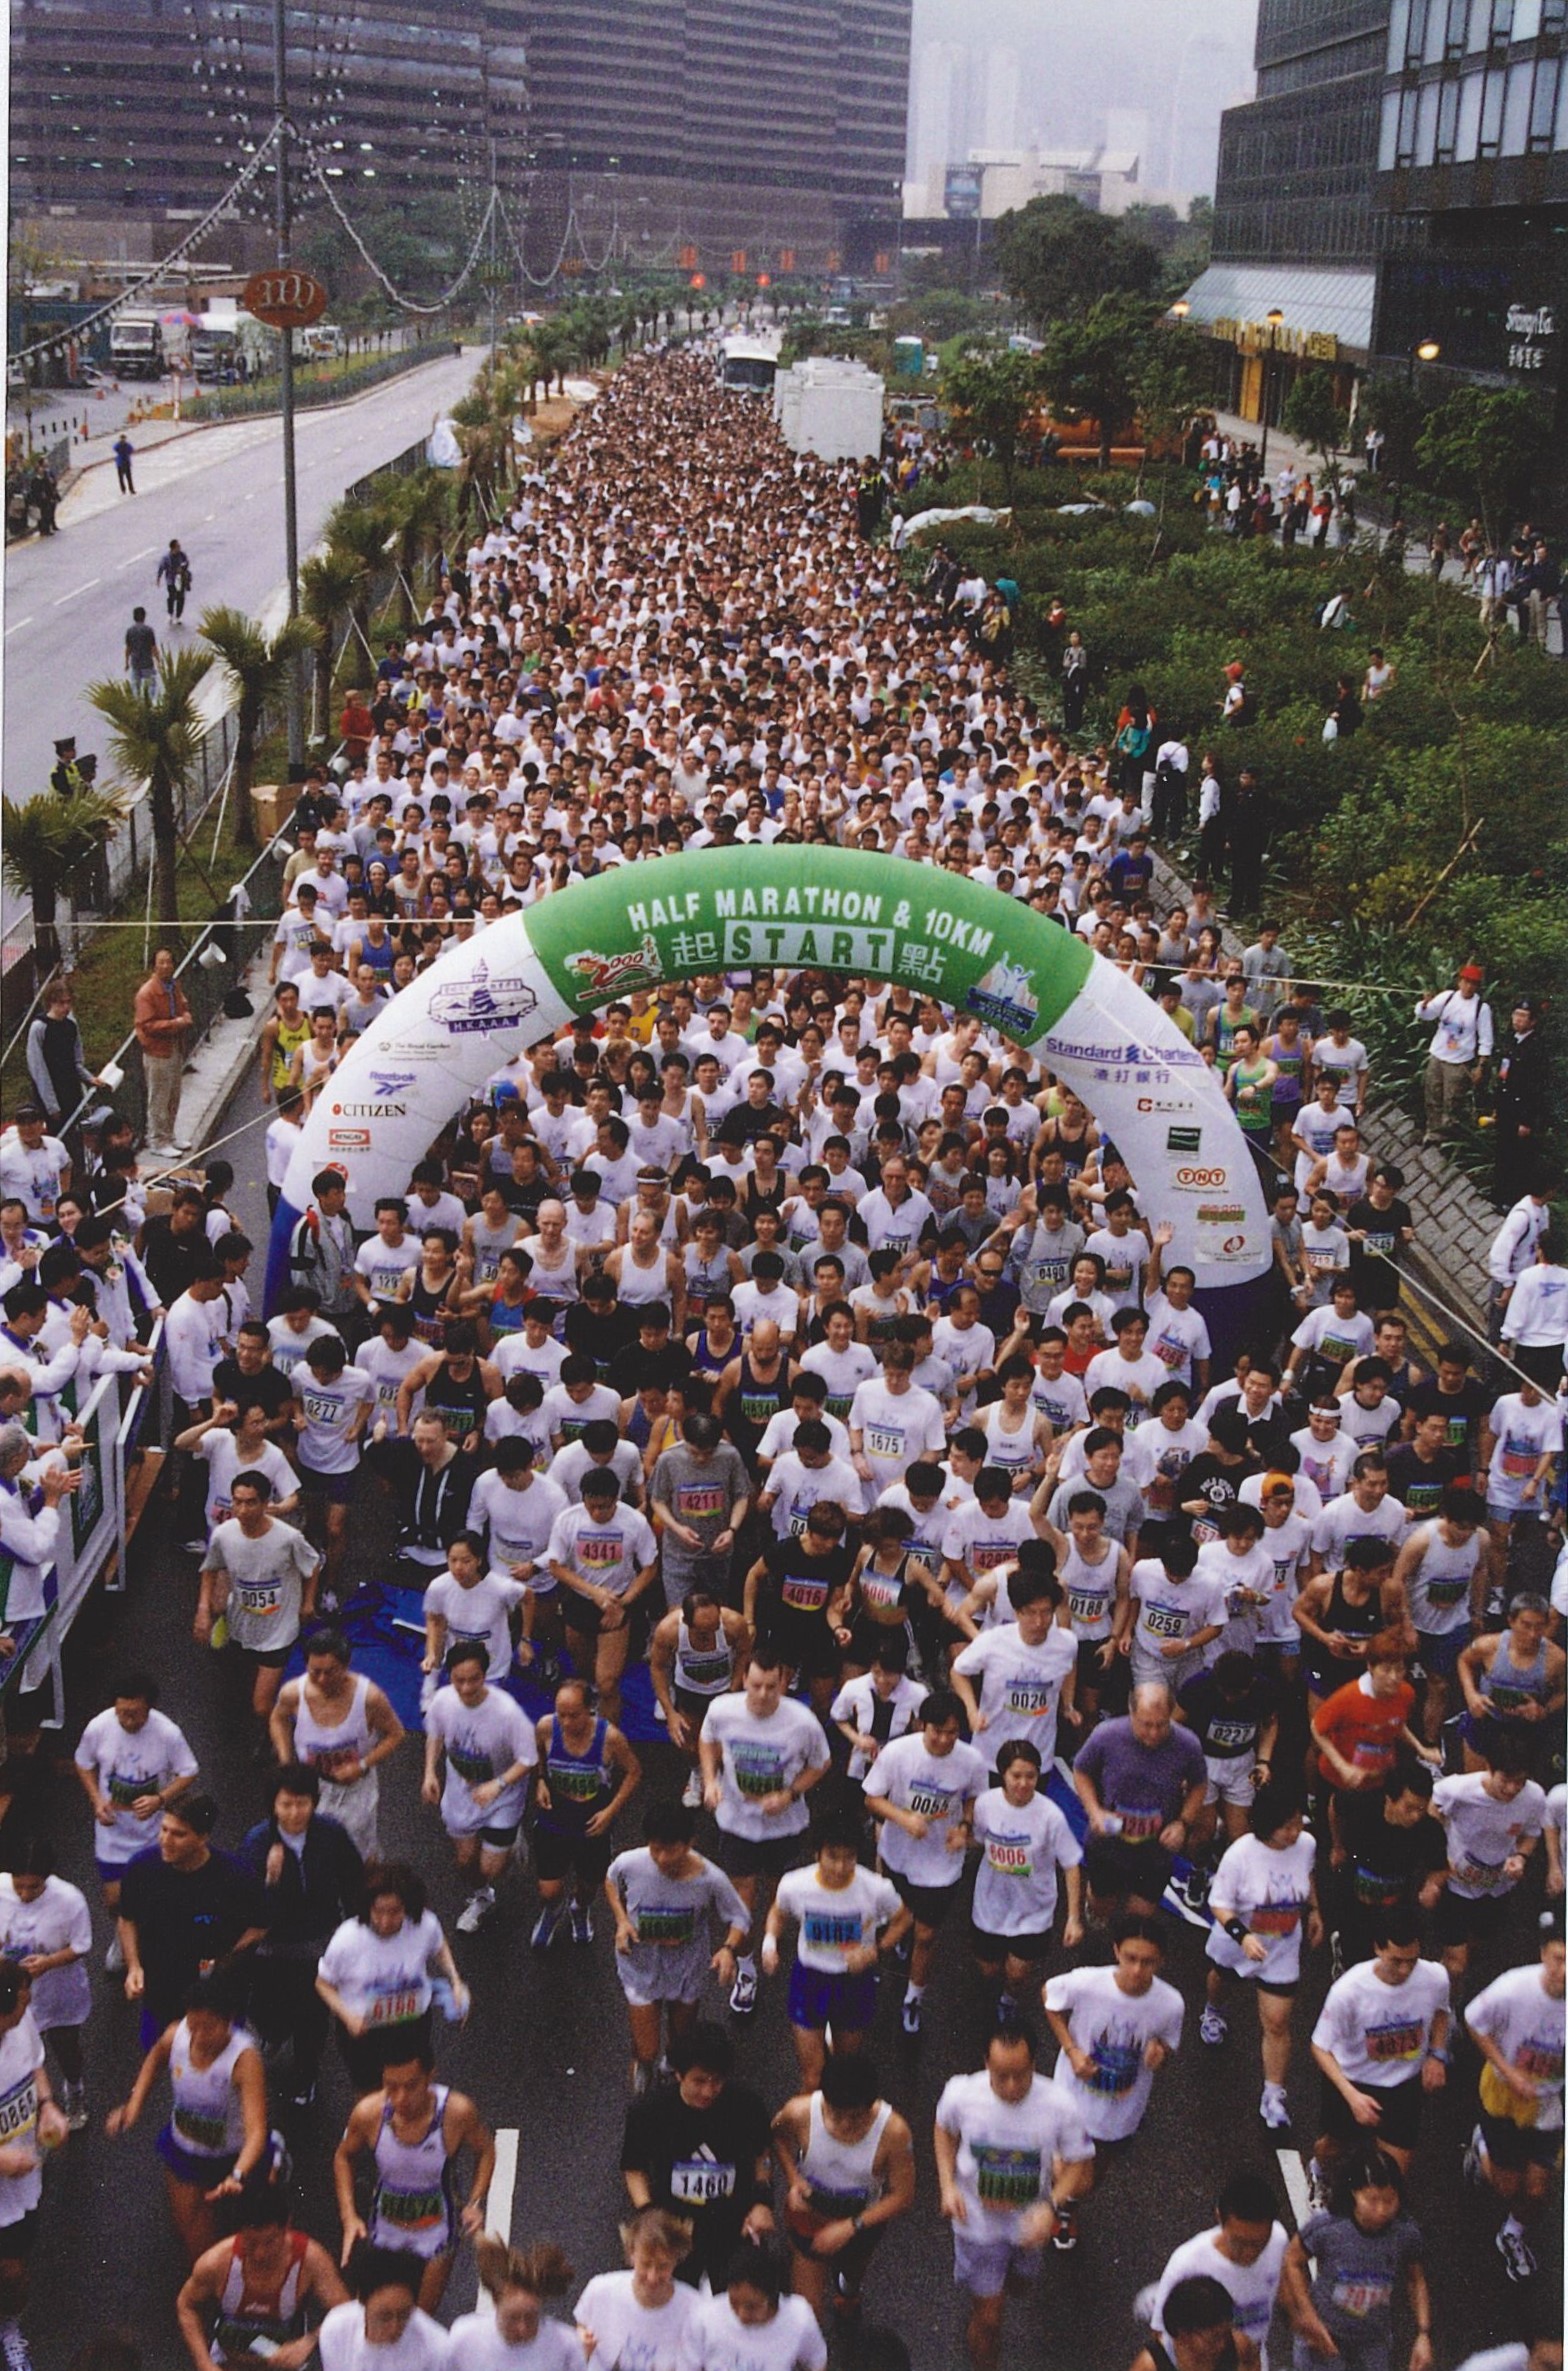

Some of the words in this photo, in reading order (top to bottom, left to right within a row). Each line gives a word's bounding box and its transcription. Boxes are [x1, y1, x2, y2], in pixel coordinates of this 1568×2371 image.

[627, 893, 699, 932] HALF
[714, 887, 882, 924] MARATHON
[893, 900, 910, 929] &
[926, 908, 995, 957] 10KM
[671, 931, 718, 967] 起
[731, 925, 887, 970] START
[897, 942, 947, 984] 點
[1046, 1037, 1122, 1060] Standard
[369, 1071, 417, 1081] Reebok
[342, 1103, 407, 1117] CITIZEN
[1182, 1171, 1221, 1182] TNT
[306, 1399, 338, 1419] 0277
[870, 1433, 900, 1454] 1675
[686, 1492, 718, 1511] 4211
[582, 1543, 617, 1561] 4341
[241, 1590, 276, 1609] 0054
[1151, 1613, 1182, 1633] 0259
